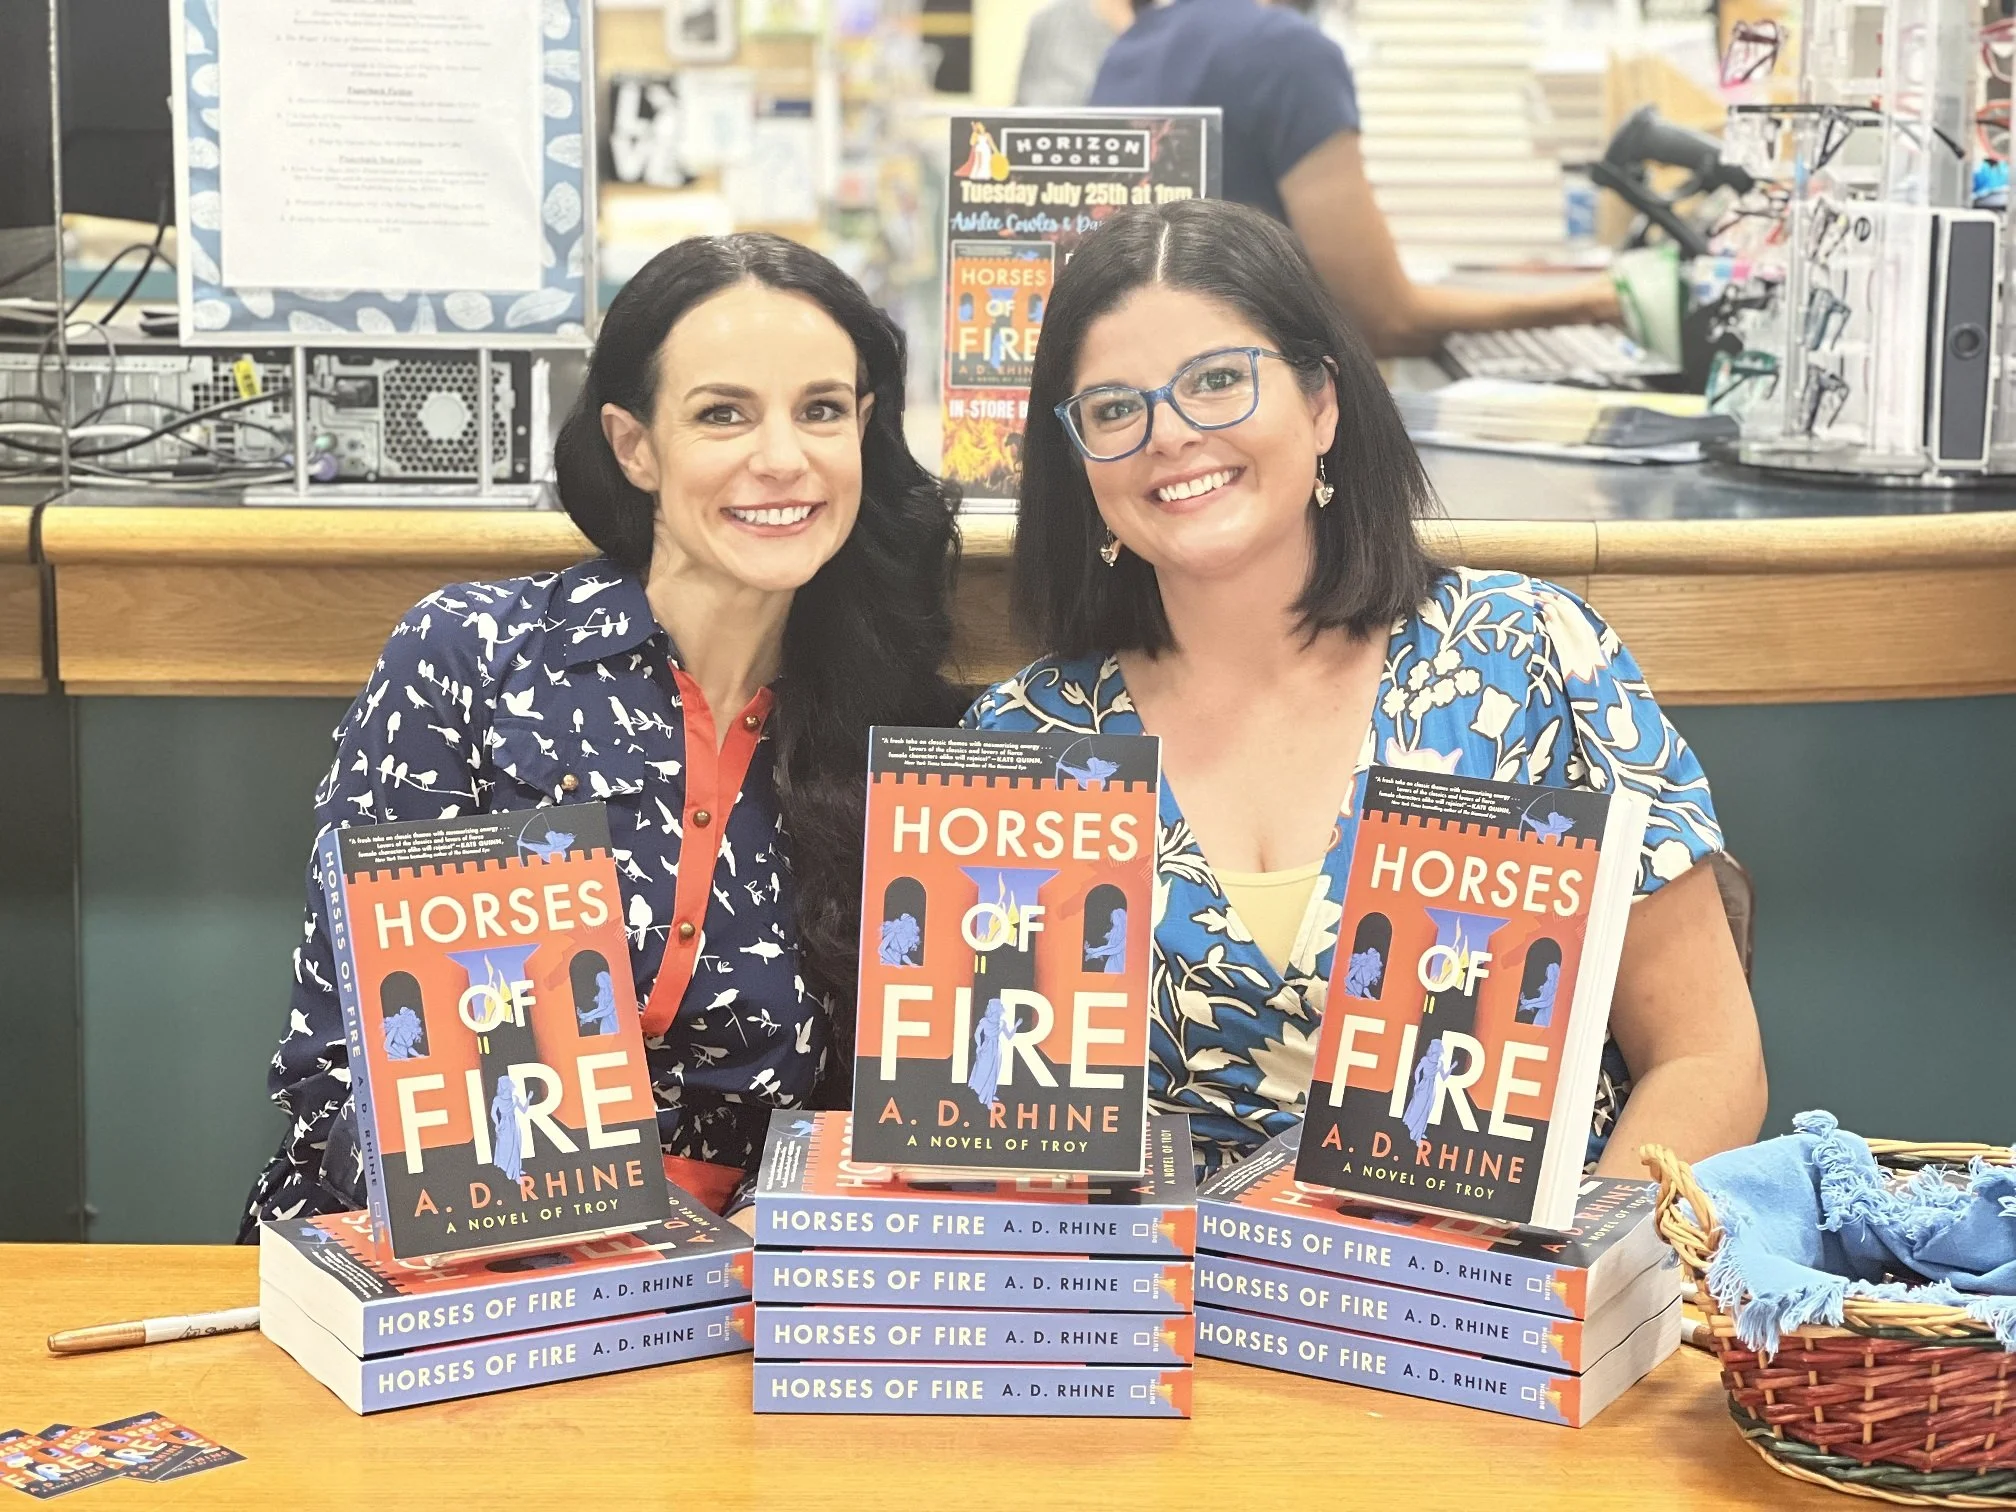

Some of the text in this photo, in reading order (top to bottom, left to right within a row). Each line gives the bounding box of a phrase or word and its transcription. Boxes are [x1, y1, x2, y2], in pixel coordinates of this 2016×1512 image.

[1017, 137, 1140, 153] HORIZON
[1032, 154, 1119, 165] BOOKS
[961, 181, 1038, 207] Tuesday
[1041, 182, 1081, 207] July
[1085, 182, 1128, 205] 25th
[1131, 184, 1151, 204] at
[961, 268, 1046, 286] HORSES
[986, 300, 1015, 318] OF
[959, 327, 1040, 361] FIRE
[950, 400, 1015, 419] IN-STORE
[894, 806, 1137, 861] HORSES
[1371, 843, 1582, 917] HORSES
[374, 880, 608, 950] HORSES
[961, 903, 1045, 952] OF
[1417, 944, 1493, 996] OF
[325, 852, 376, 1185] HORSES OF FIRE A. D. RHINE
[459, 979, 536, 1032] OF
[880, 984, 1128, 1089] FIRE
[1328, 1014, 1549, 1142] FIRE
[396, 1050, 641, 1175] FIRE
[879, 1097, 1119, 1133] A. D. RHINE
[907, 1135, 1088, 1153] A NOVEL OF TROY
[1321, 1123, 1525, 1184] A. D. RHINE
[414, 1160, 644, 1217] A. D. RHINE
[1343, 1163, 1495, 1200] A NOVEL OF TROY
[1574, 1184, 1634, 1221] RHINE
[447, 1199, 619, 1234] A NOVEL OF TROY
[772, 1211, 1117, 1235] HORSES OF FIRE A. D. RHINE
[1203, 1215, 1512, 1287] HORSES OF FIRE A. D. RHINE
[774, 1268, 1118, 1291] HORSES OF FIRE A. D. RHINE
[378, 1274, 693, 1335] HORSES OF FIRE A. D. RHINE
[1200, 1269, 1509, 1339] HORSES OF FIRE A. D. RHINE
[774, 1324, 1118, 1346] HORSES OF FIRE A. D. RHINE
[378, 1328, 694, 1394] HORSES OF FIRE A. D. RHINE
[1200, 1322, 1507, 1395] HORSES OF FIRE A. D. RHINE
[772, 1379, 1115, 1399] HORSES OF FIRE A. D. RHINE
[2, 1455, 95, 1488] FIRE
